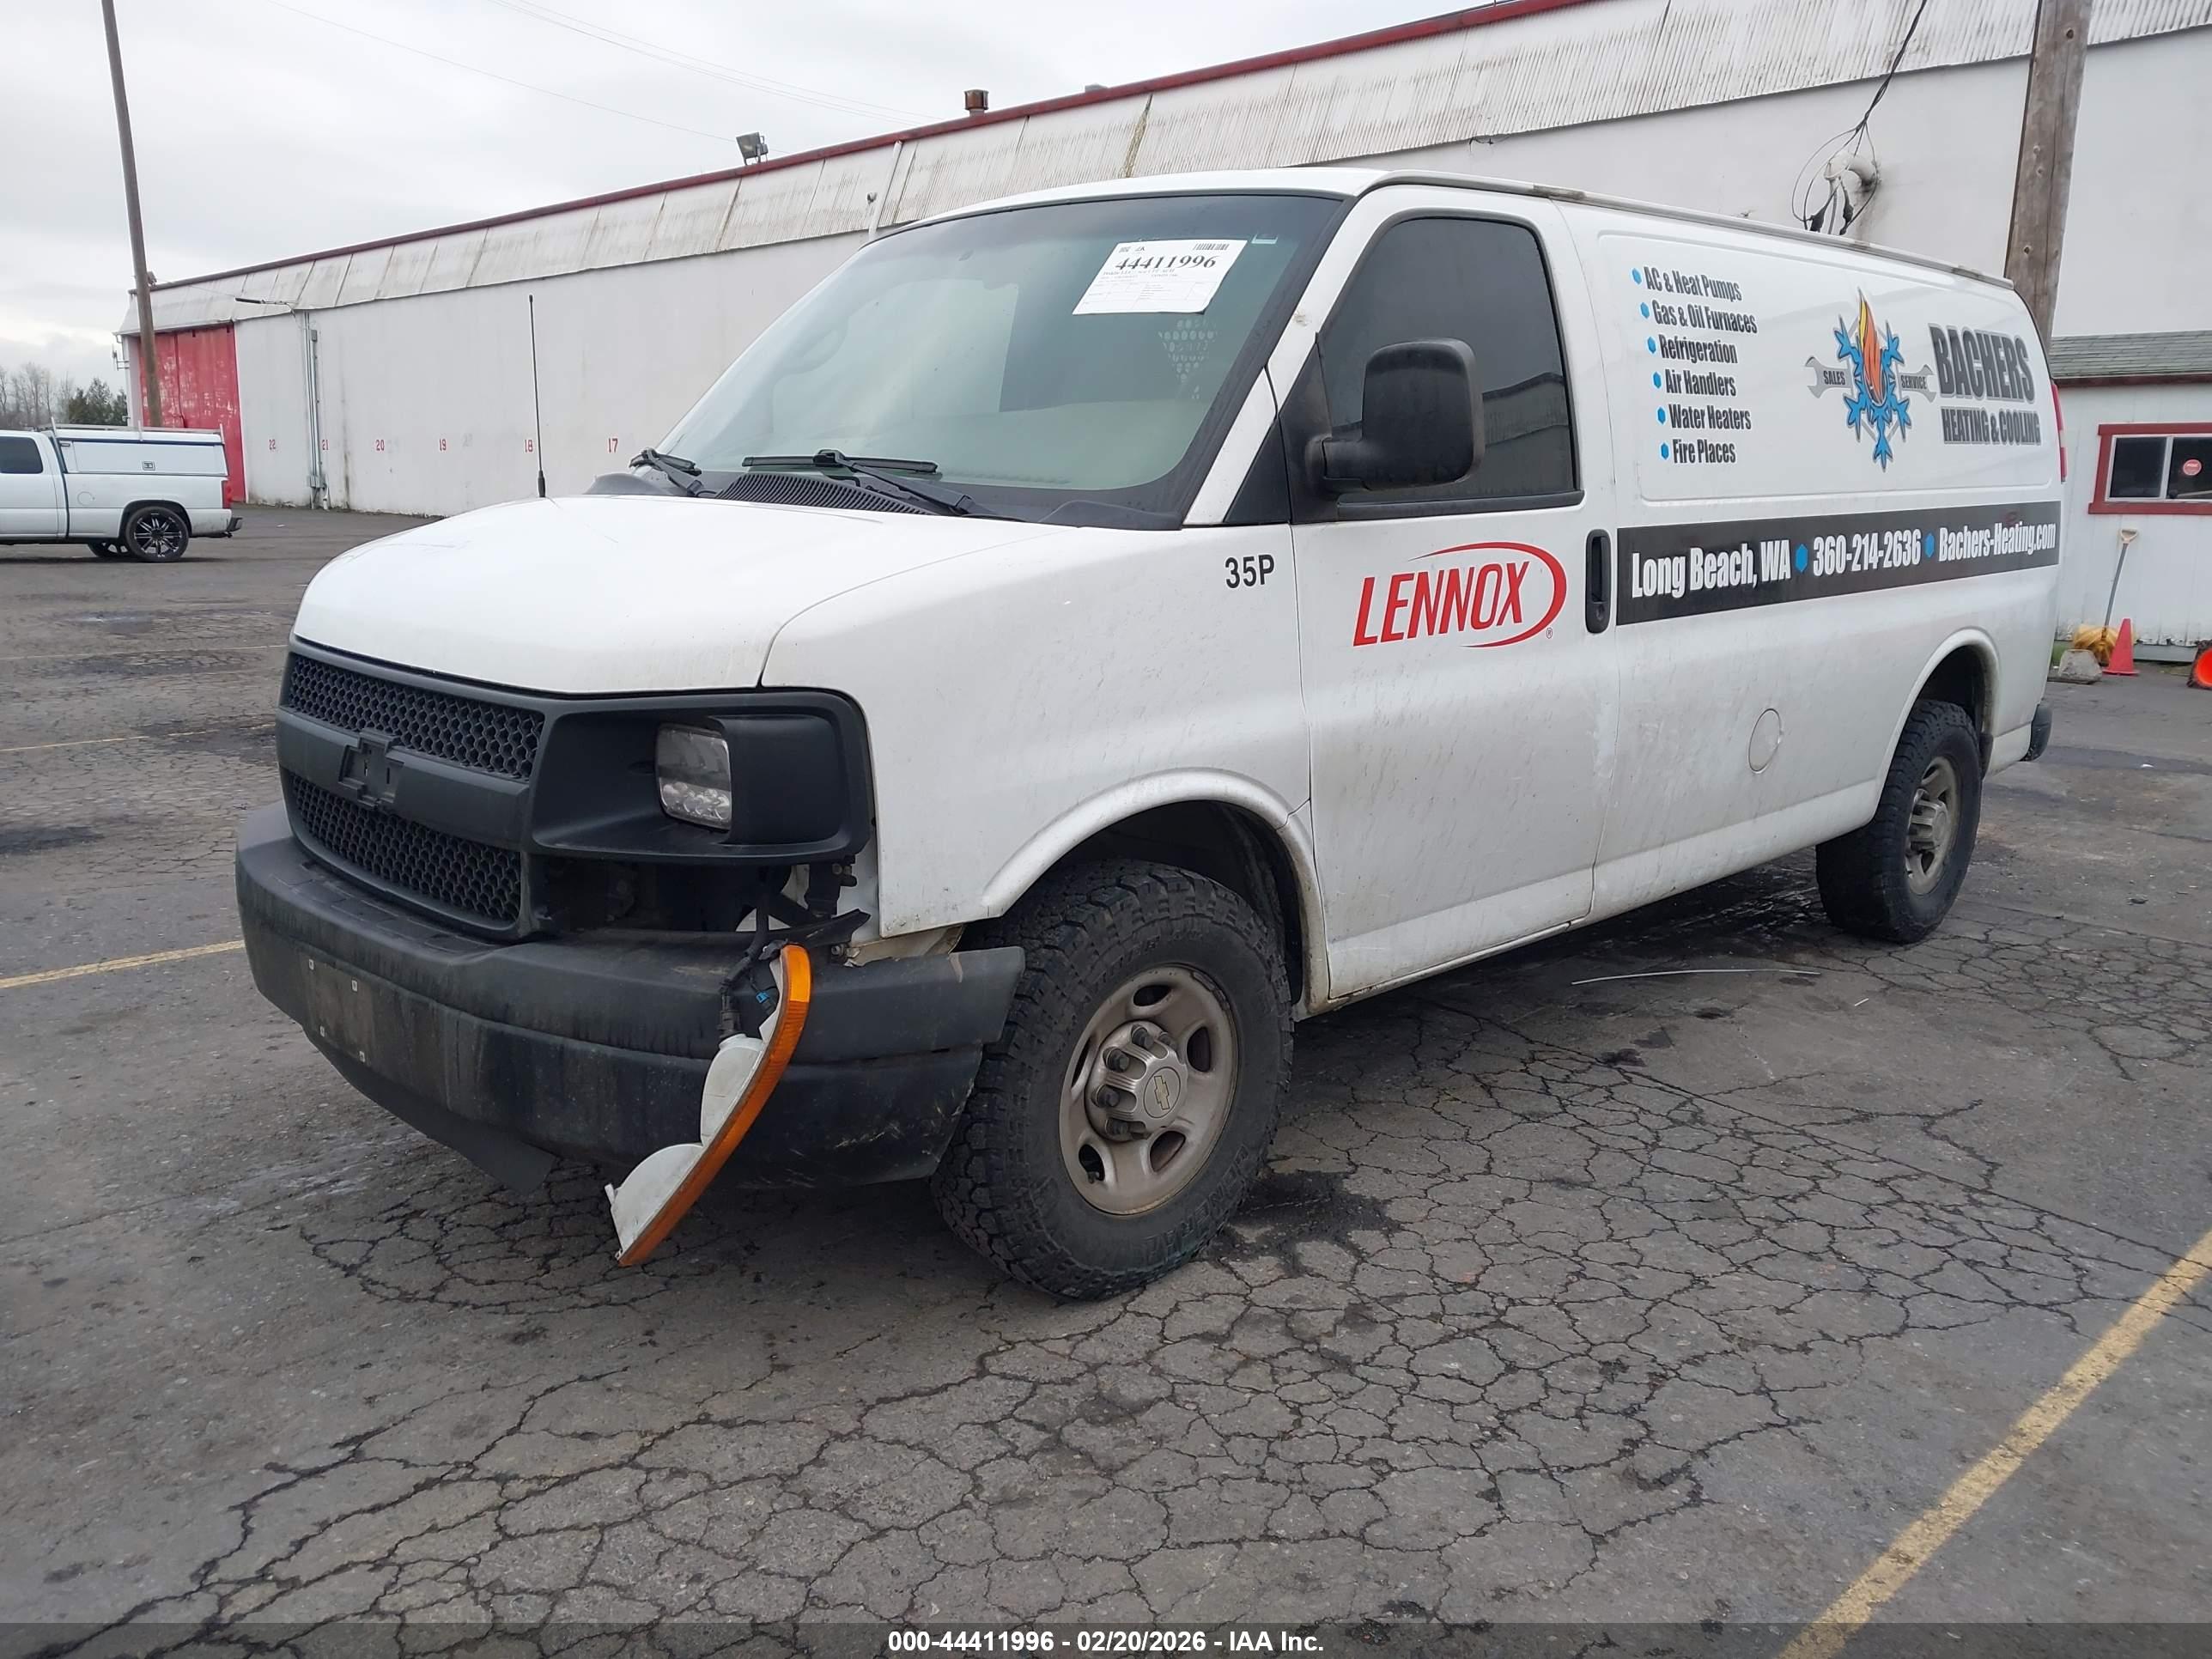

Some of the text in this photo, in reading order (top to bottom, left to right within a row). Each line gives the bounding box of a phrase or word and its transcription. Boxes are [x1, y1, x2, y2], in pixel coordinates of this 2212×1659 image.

[1115, 255, 1220, 270] 44411996
[1644, 266, 1742, 301] AC & Heat Pumps
[1652, 300, 1758, 333] Gas & Oil Furnaces
[1658, 334, 1738, 364] Refrigeration
[1928, 322, 2036, 404] BACHERS
[1665, 368, 1736, 396] Air Handlers
[1823, 370, 1846, 386] SALES
[1900, 374, 1927, 390] SERVICE
[1668, 404, 1752, 430] Water Heaters
[1941, 406, 2041, 446] HEATING & COOLING
[269, 439, 276, 450] 22
[322, 439, 329, 451] 21
[376, 439, 385, 451] 20
[439, 438, 447, 452] 19
[524, 439, 533, 453] 18
[608, 438, 618, 453] 17
[1673, 439, 1736, 464] Fire Places
[1224, 554, 1275, 588] 35P
[1632, 520, 2057, 599] Long Beach, WA 360-214-2636 Bachers-Heating.com
[1352, 561, 1530, 647] LENNOX
